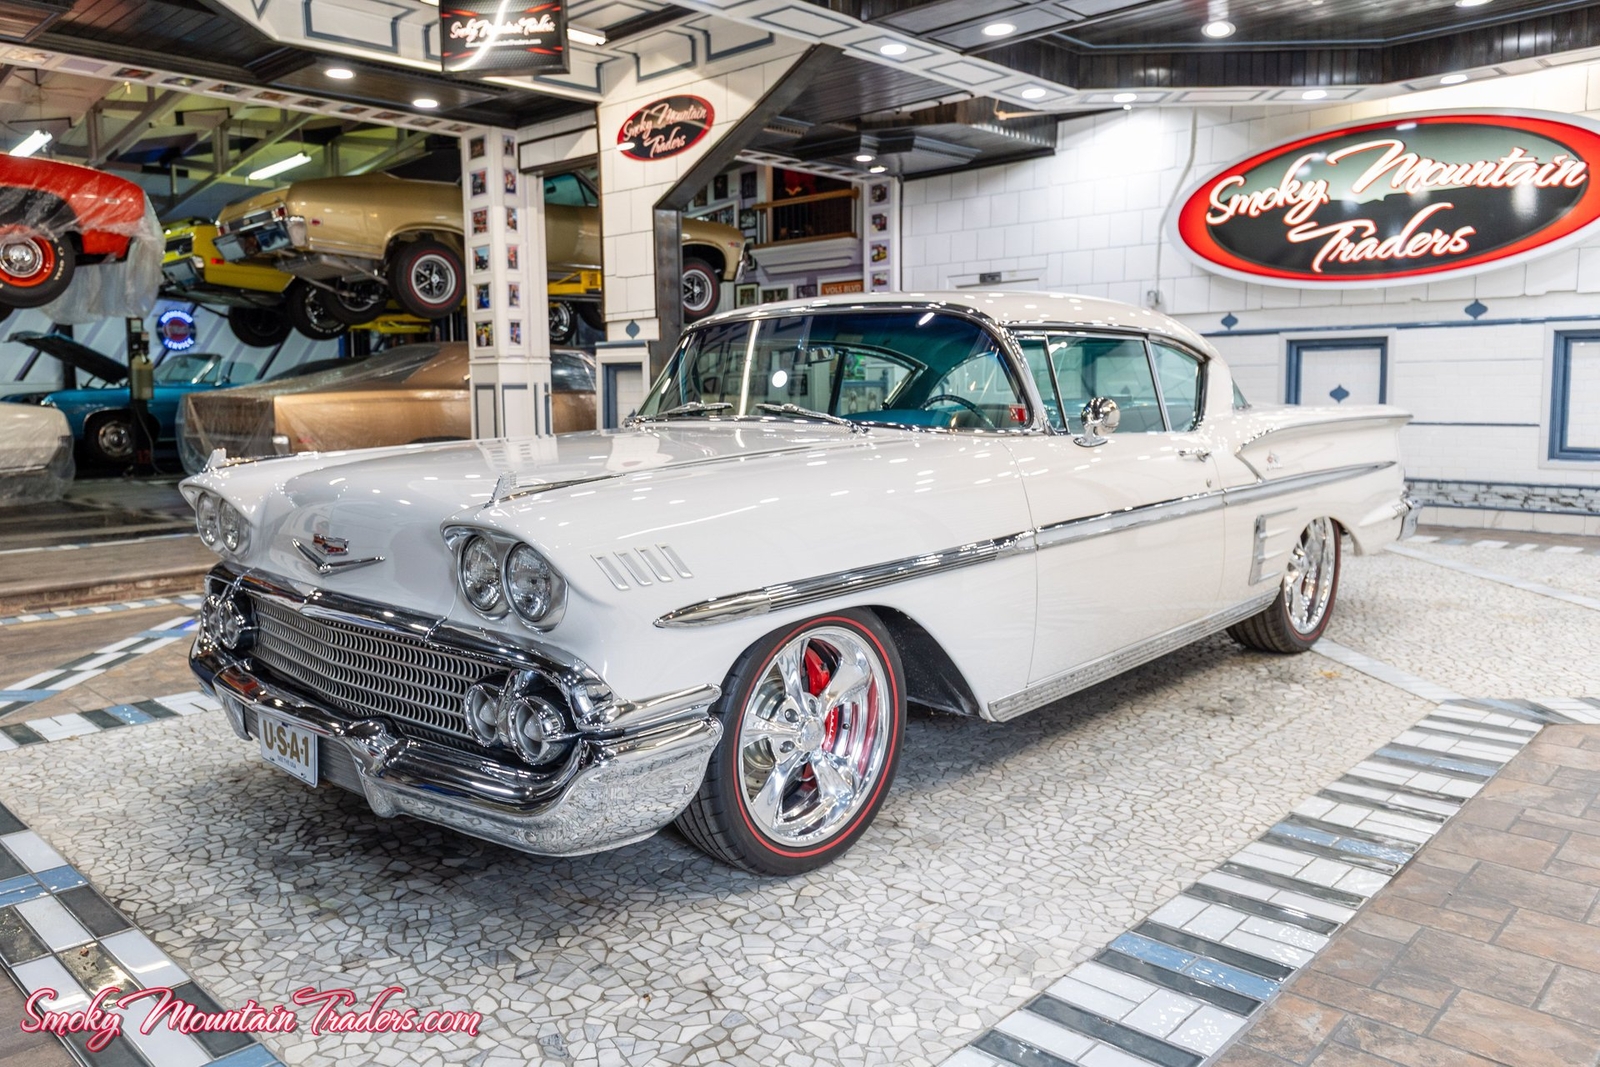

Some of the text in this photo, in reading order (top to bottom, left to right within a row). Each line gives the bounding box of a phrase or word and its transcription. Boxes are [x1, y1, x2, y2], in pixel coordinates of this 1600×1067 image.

[623, 102, 707, 141] Smoky Mountain
[643, 126, 687, 158] Traders
[1206, 138, 1590, 226] Smoky Mountain
[1286, 201, 1477, 274] Traders
